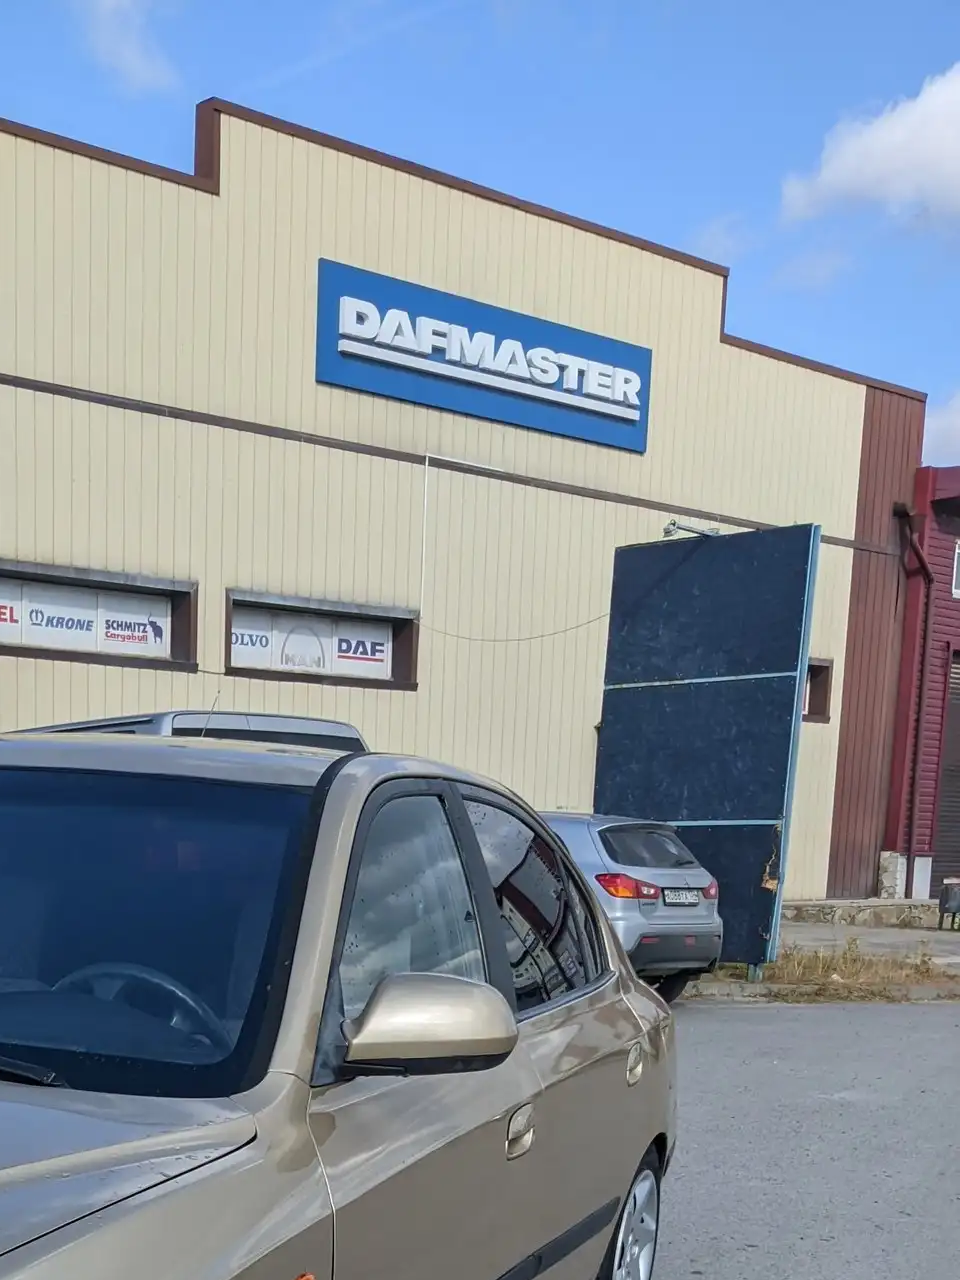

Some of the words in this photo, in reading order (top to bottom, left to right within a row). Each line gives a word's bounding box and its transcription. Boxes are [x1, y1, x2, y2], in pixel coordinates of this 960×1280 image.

[339, 296, 641, 406] DAFMASTER
[44, 615, 94, 631] KRONE
[104, 619, 148, 634] SCHMITZ
[104, 630, 148, 643] Cargobull
[231, 632, 269, 647] OLVO
[337, 638, 385, 657] DAF
